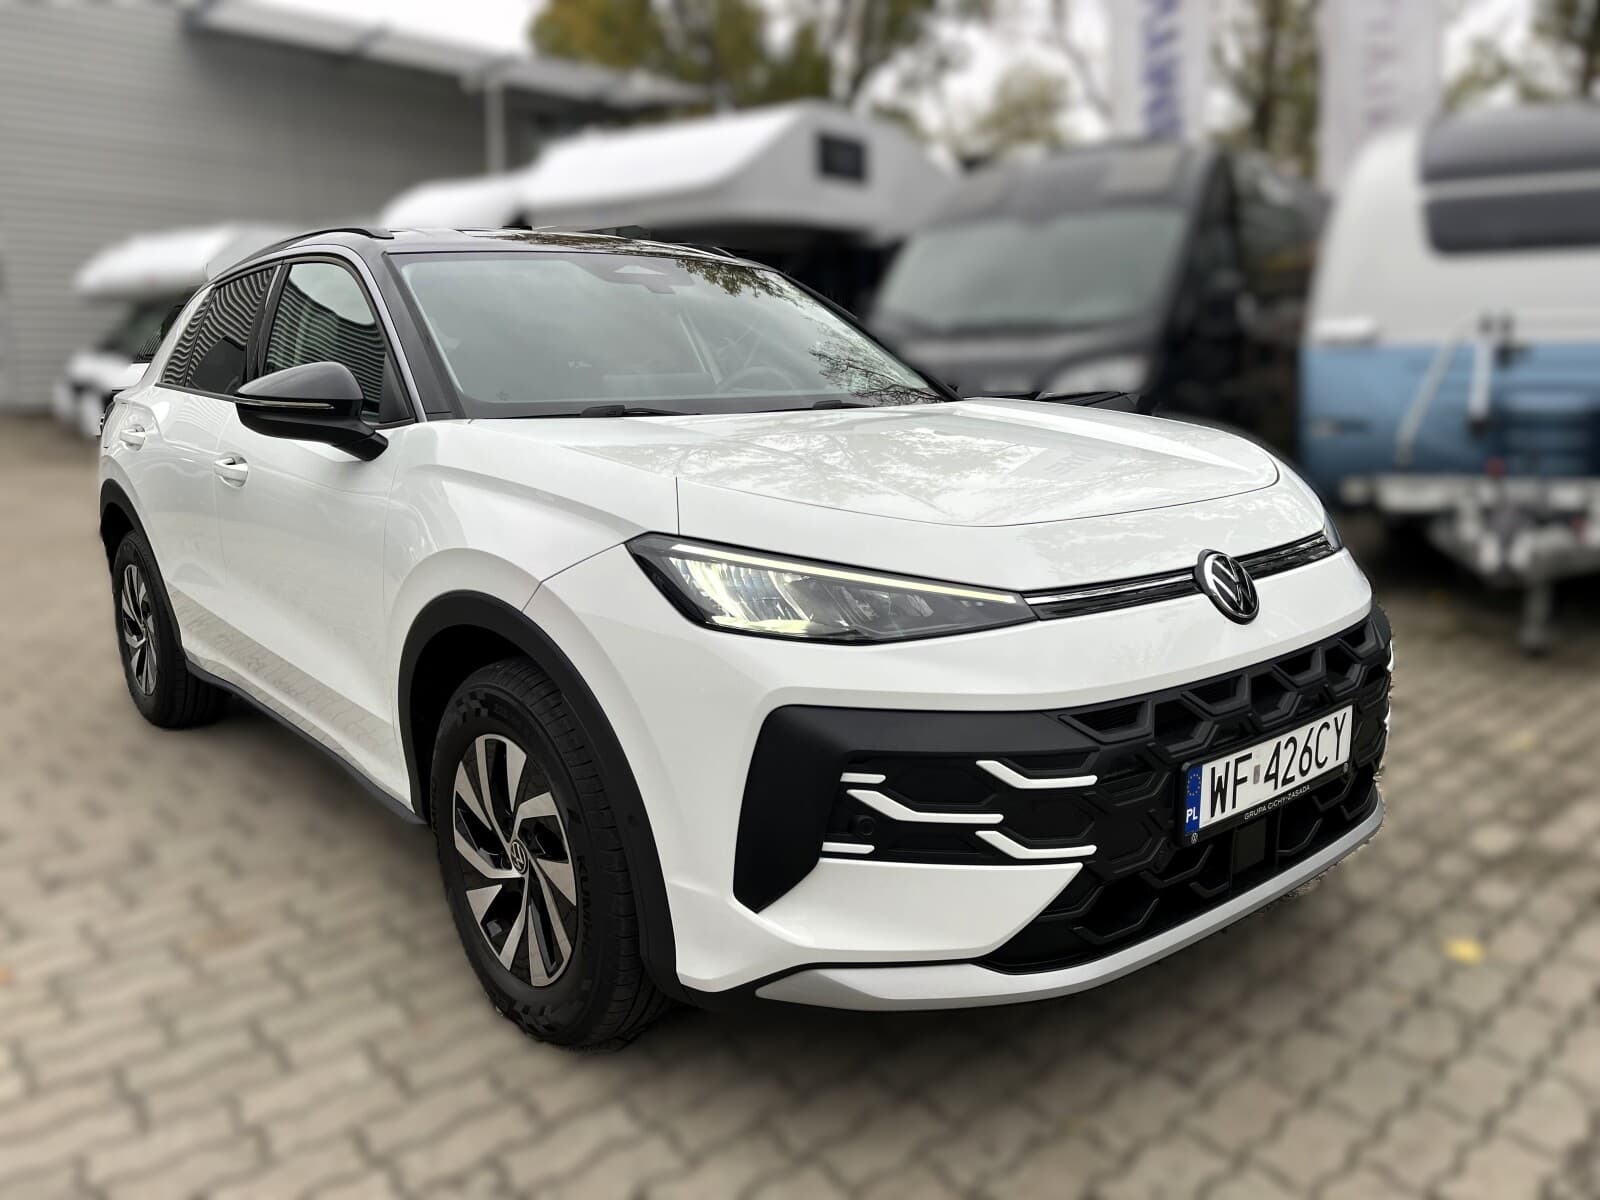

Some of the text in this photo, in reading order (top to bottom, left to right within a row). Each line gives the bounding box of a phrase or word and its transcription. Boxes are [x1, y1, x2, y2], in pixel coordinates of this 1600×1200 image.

[1210, 711, 1347, 818] WF 426CY
[1185, 806, 1198, 824] PL
[1244, 805, 1267, 820] GRUPA
